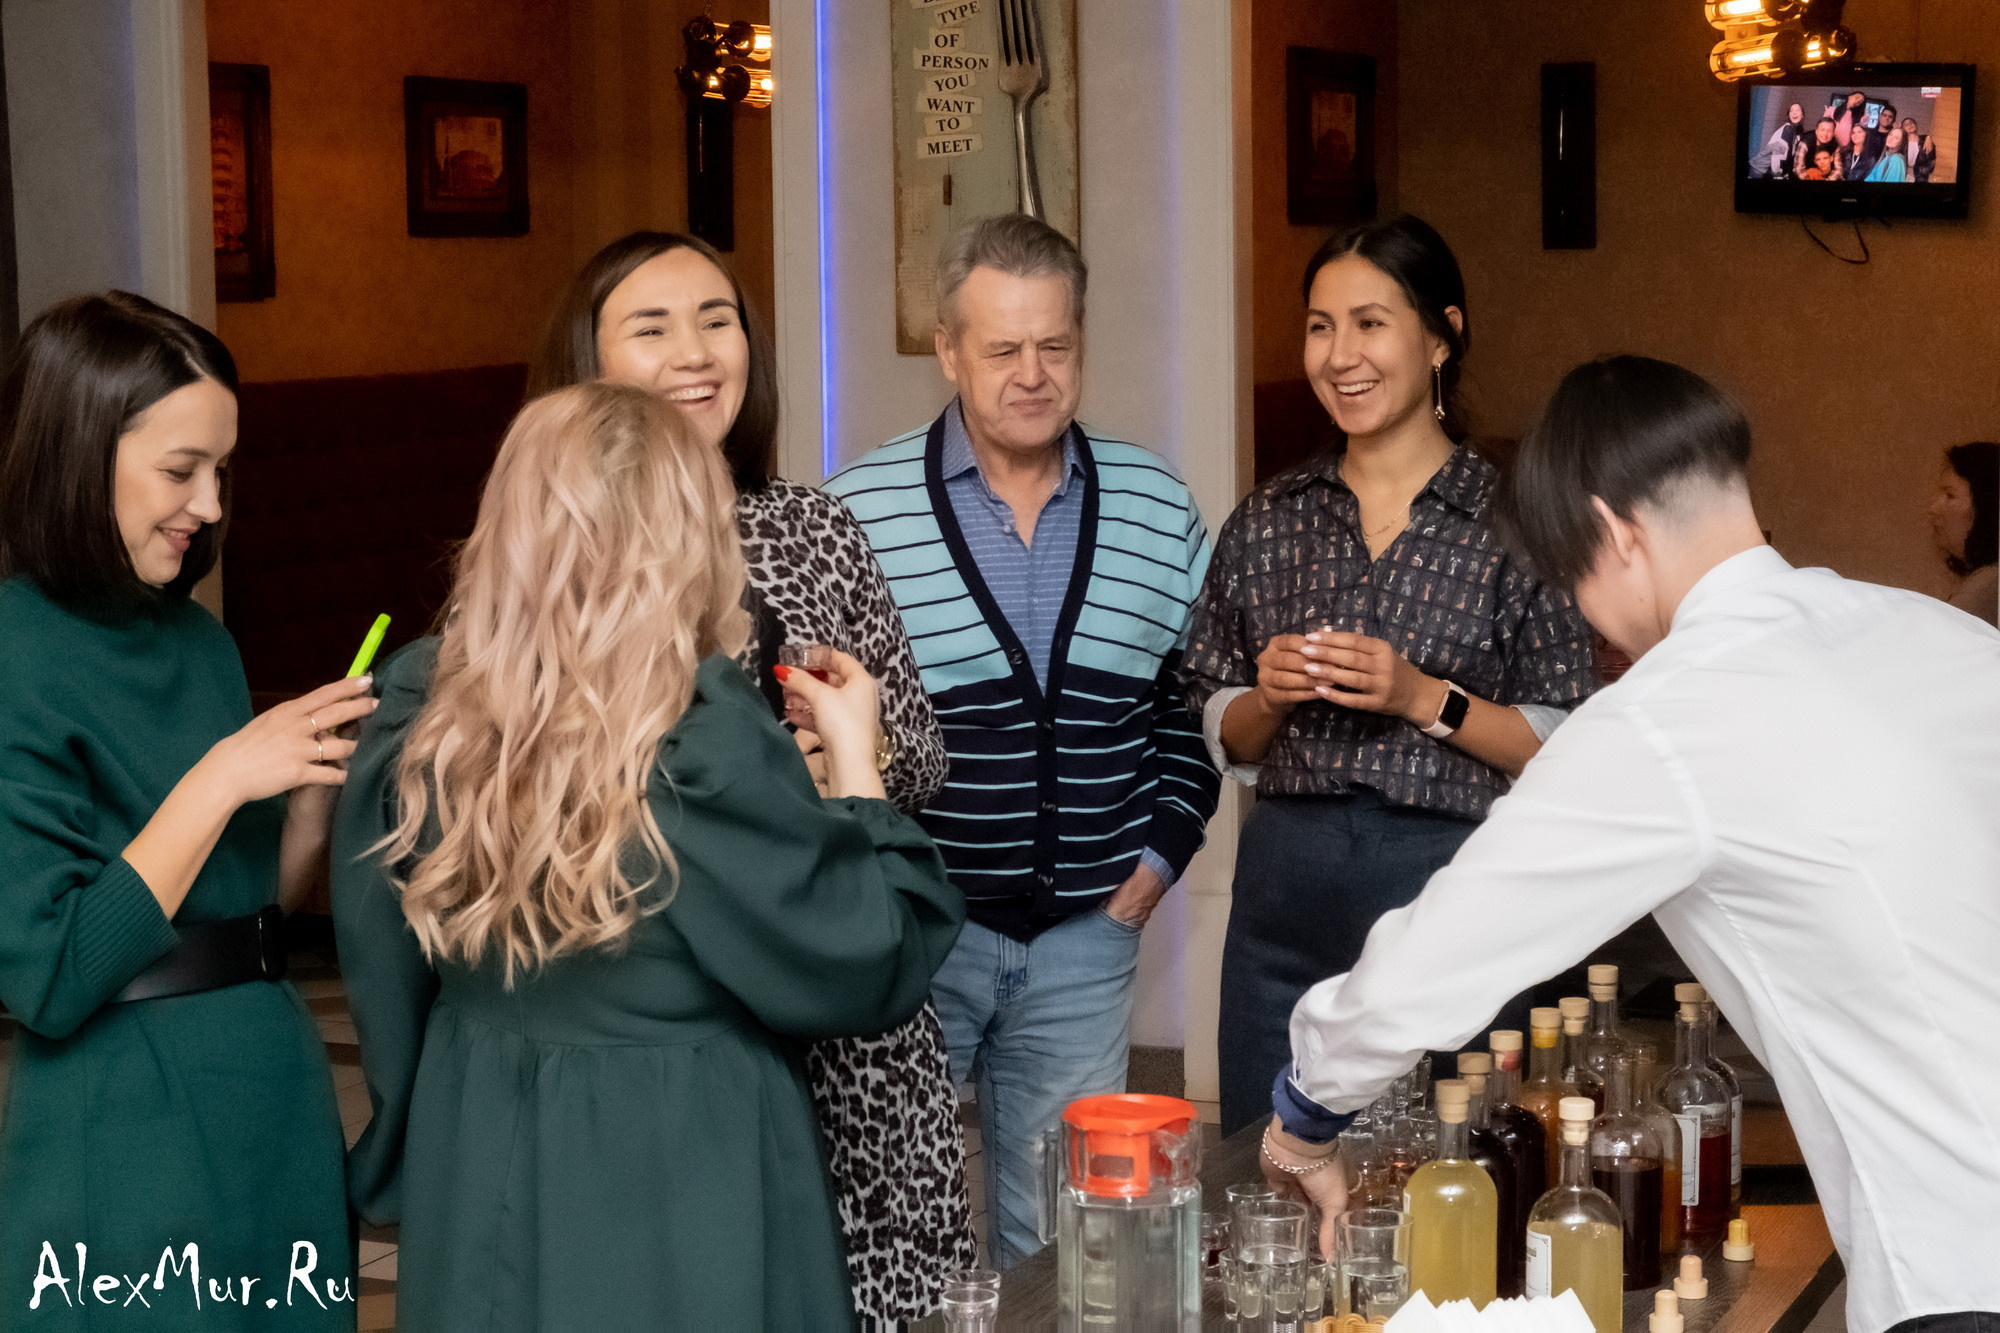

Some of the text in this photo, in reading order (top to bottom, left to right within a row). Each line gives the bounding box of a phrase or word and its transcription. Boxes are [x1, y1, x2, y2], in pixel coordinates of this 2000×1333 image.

[938, 1, 980, 24] TYPE
[934, 33, 960, 48] OF
[921, 54, 989, 70] PERSON
[934, 74, 970, 92] YOU
[926, 98, 975, 114] WANT
[936, 117, 960, 132] TO
[927, 138, 973, 155] MEET
